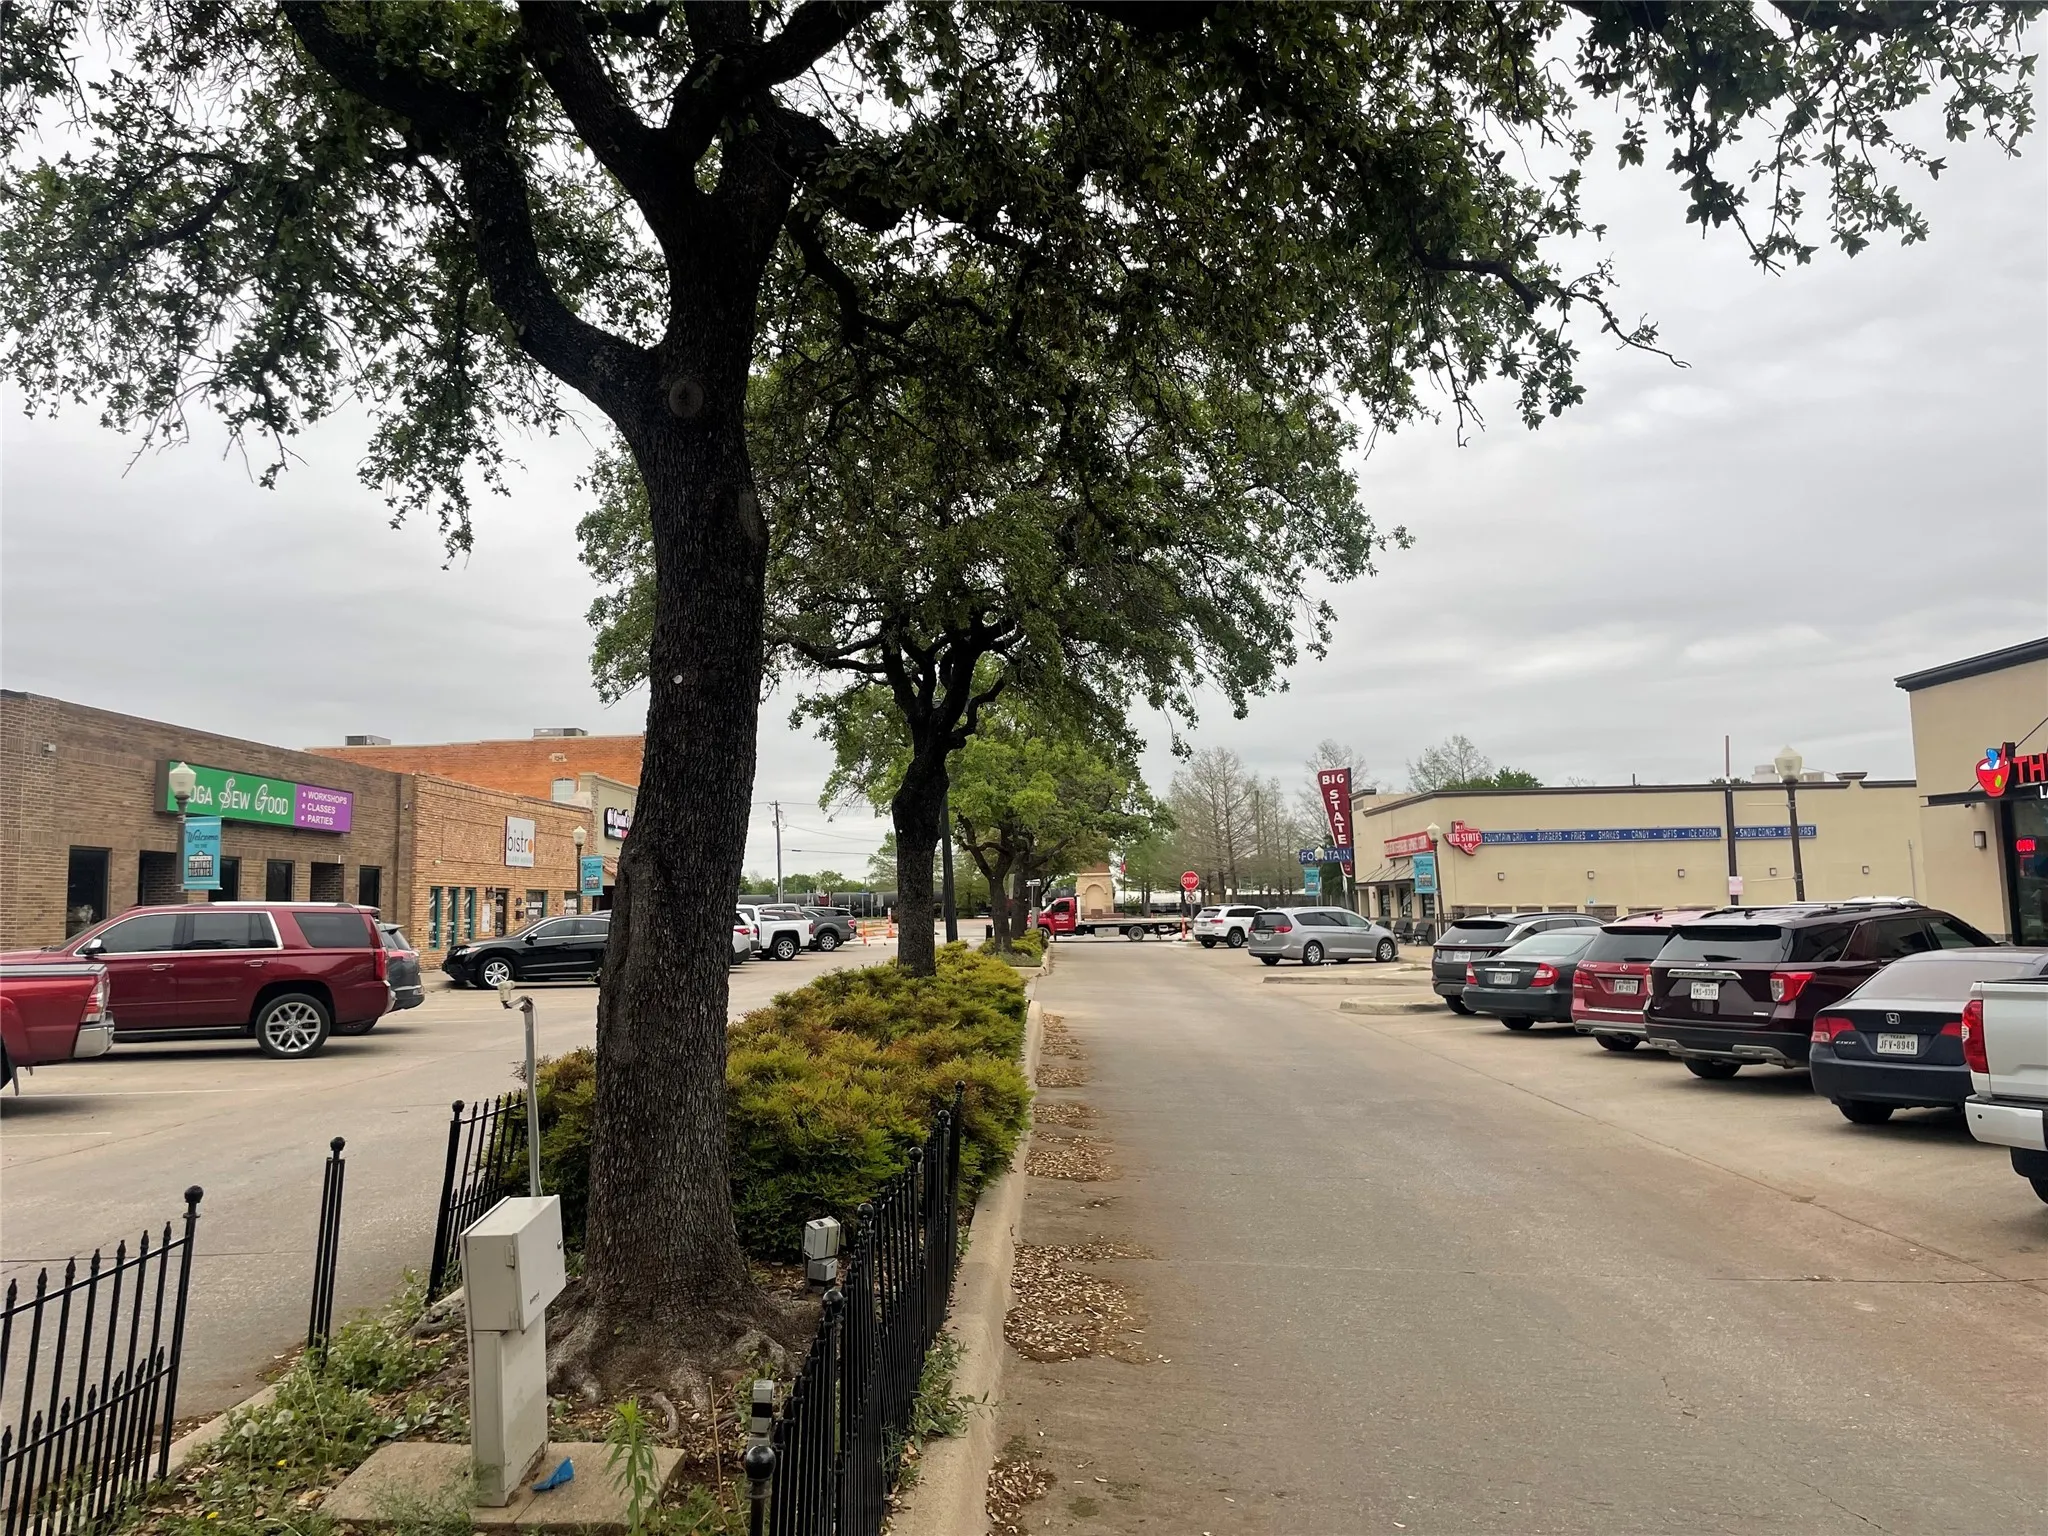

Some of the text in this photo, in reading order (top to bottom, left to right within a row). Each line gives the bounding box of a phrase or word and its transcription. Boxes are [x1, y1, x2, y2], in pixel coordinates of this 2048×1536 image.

[2013, 752, 2048, 784] TH
[1322, 774, 1344, 784] BIG
[188, 785, 212, 805] OGA
[308, 791, 347, 804] WORKSHOPS
[2040, 785, 2048, 799] L
[307, 803, 336, 814] CLASSES
[307, 815, 333, 825] PARTIES
[1329, 789, 1347, 844] STATE
[186, 829, 218, 843] Welcome
[1461, 832, 1480, 842] STATE
[1537, 831, 1562, 840] BURGERS
[1570, 831, 1586, 840] FRIES
[1598, 830, 1620, 840] SHAKES
[1631, 829, 1649, 839] CANDY
[1662, 829, 1677, 838] GIFTS
[1688, 828, 1698, 838] ICE
[1698, 828, 1718, 838] CREAM
[1739, 827, 1757, 837] SNOW
[1758, 827, 1776, 837] CONES
[1783, 826, 1814, 836] BRFAST
[508, 827, 533, 853] bistro
[1301, 850, 1350, 861] FONTAIN
[1183, 876, 1198, 885] STOP
[1879, 1040, 1916, 1051] JFV-8949
